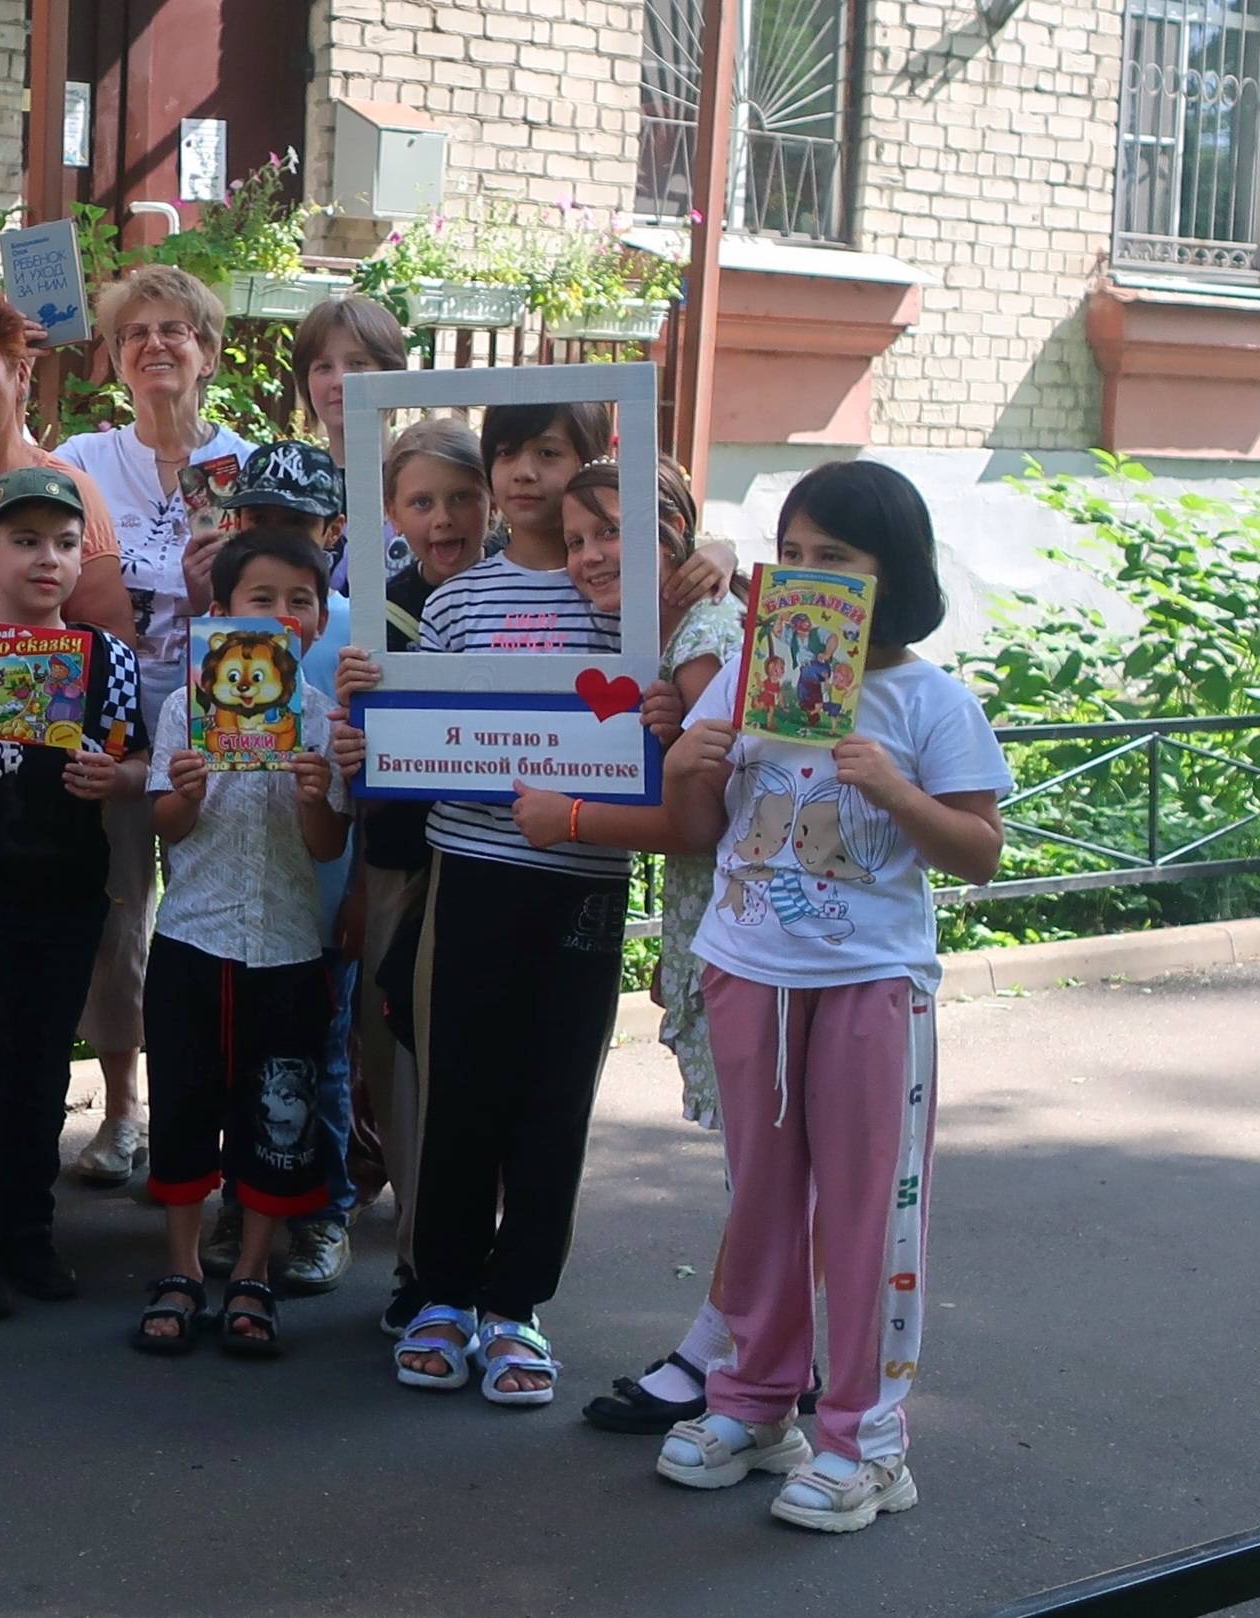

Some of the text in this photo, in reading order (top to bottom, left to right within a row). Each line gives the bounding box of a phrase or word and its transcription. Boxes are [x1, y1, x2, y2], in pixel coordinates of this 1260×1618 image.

[30, 264, 64, 280] УХОД
[38, 277, 68, 292] НИМ
[445, 727, 560, 747] Я читаю в
[378, 754, 639, 778] Батенинской библиотеке
